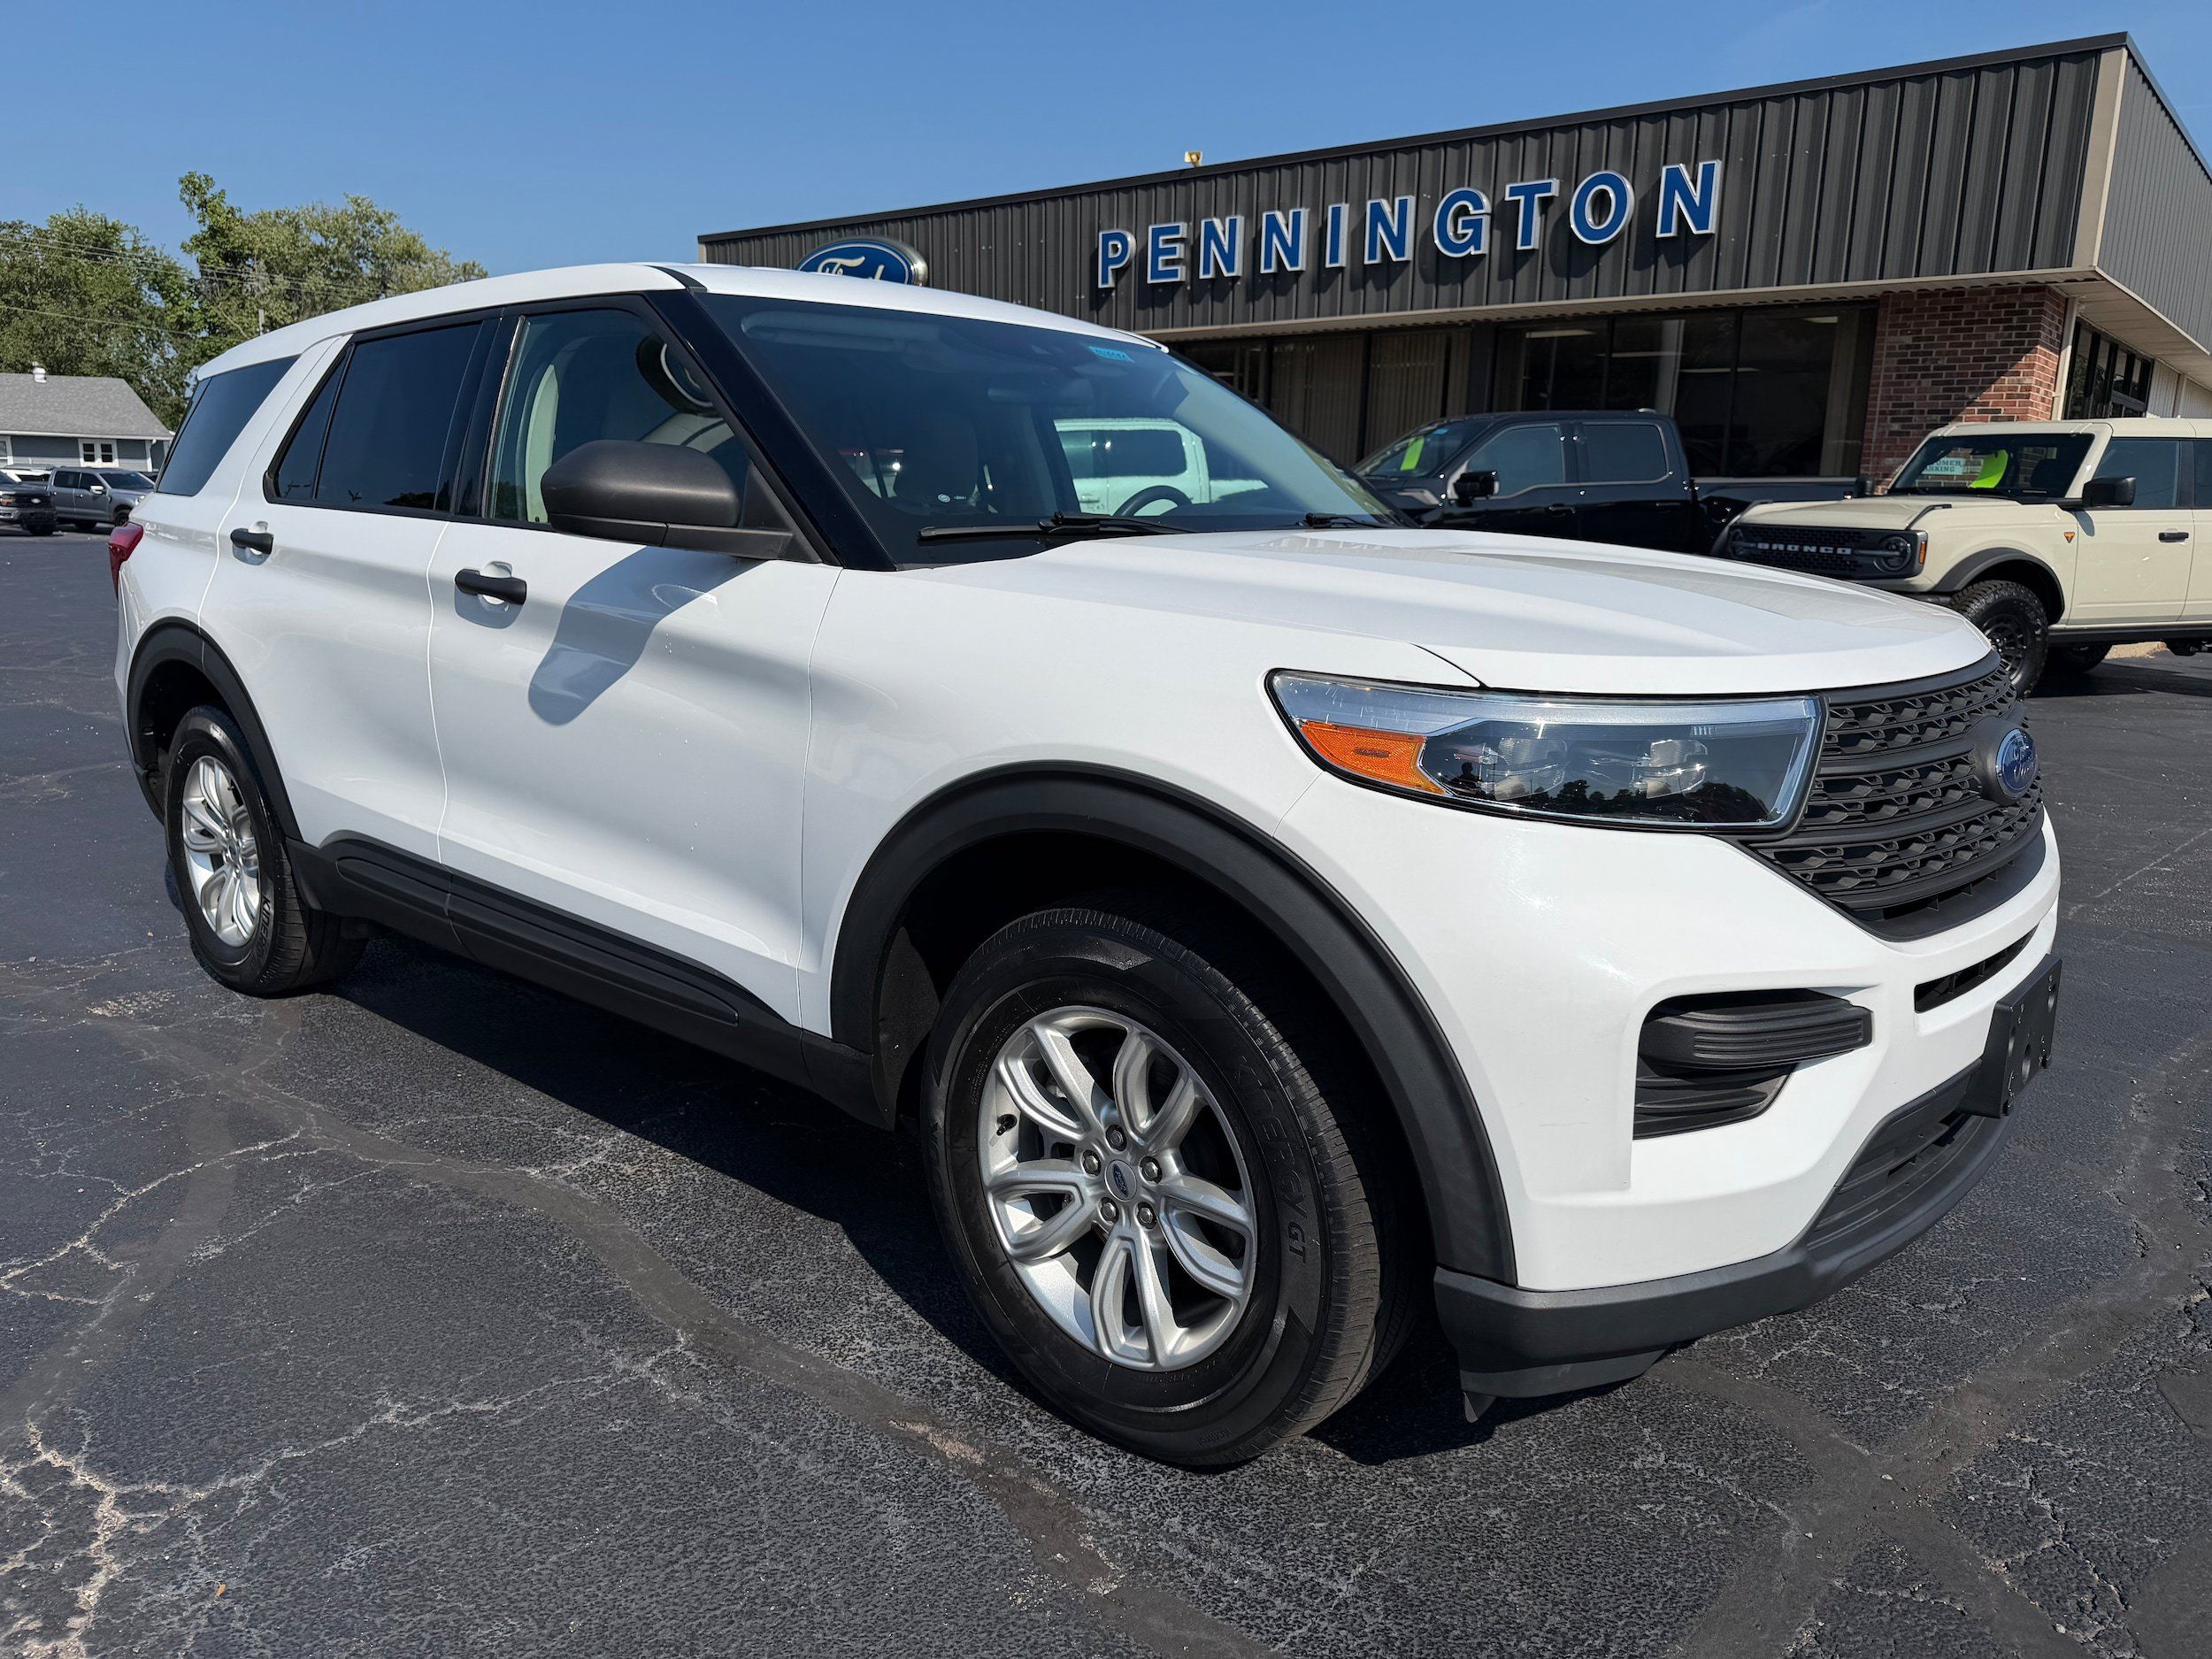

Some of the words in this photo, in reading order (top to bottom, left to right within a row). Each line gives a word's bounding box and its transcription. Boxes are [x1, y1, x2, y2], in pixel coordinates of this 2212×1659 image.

[1098, 159, 1722, 289] PENNINGTON
[1756, 542, 1852, 556] BRONCO
[1288, 1221, 1307, 1264] GT
